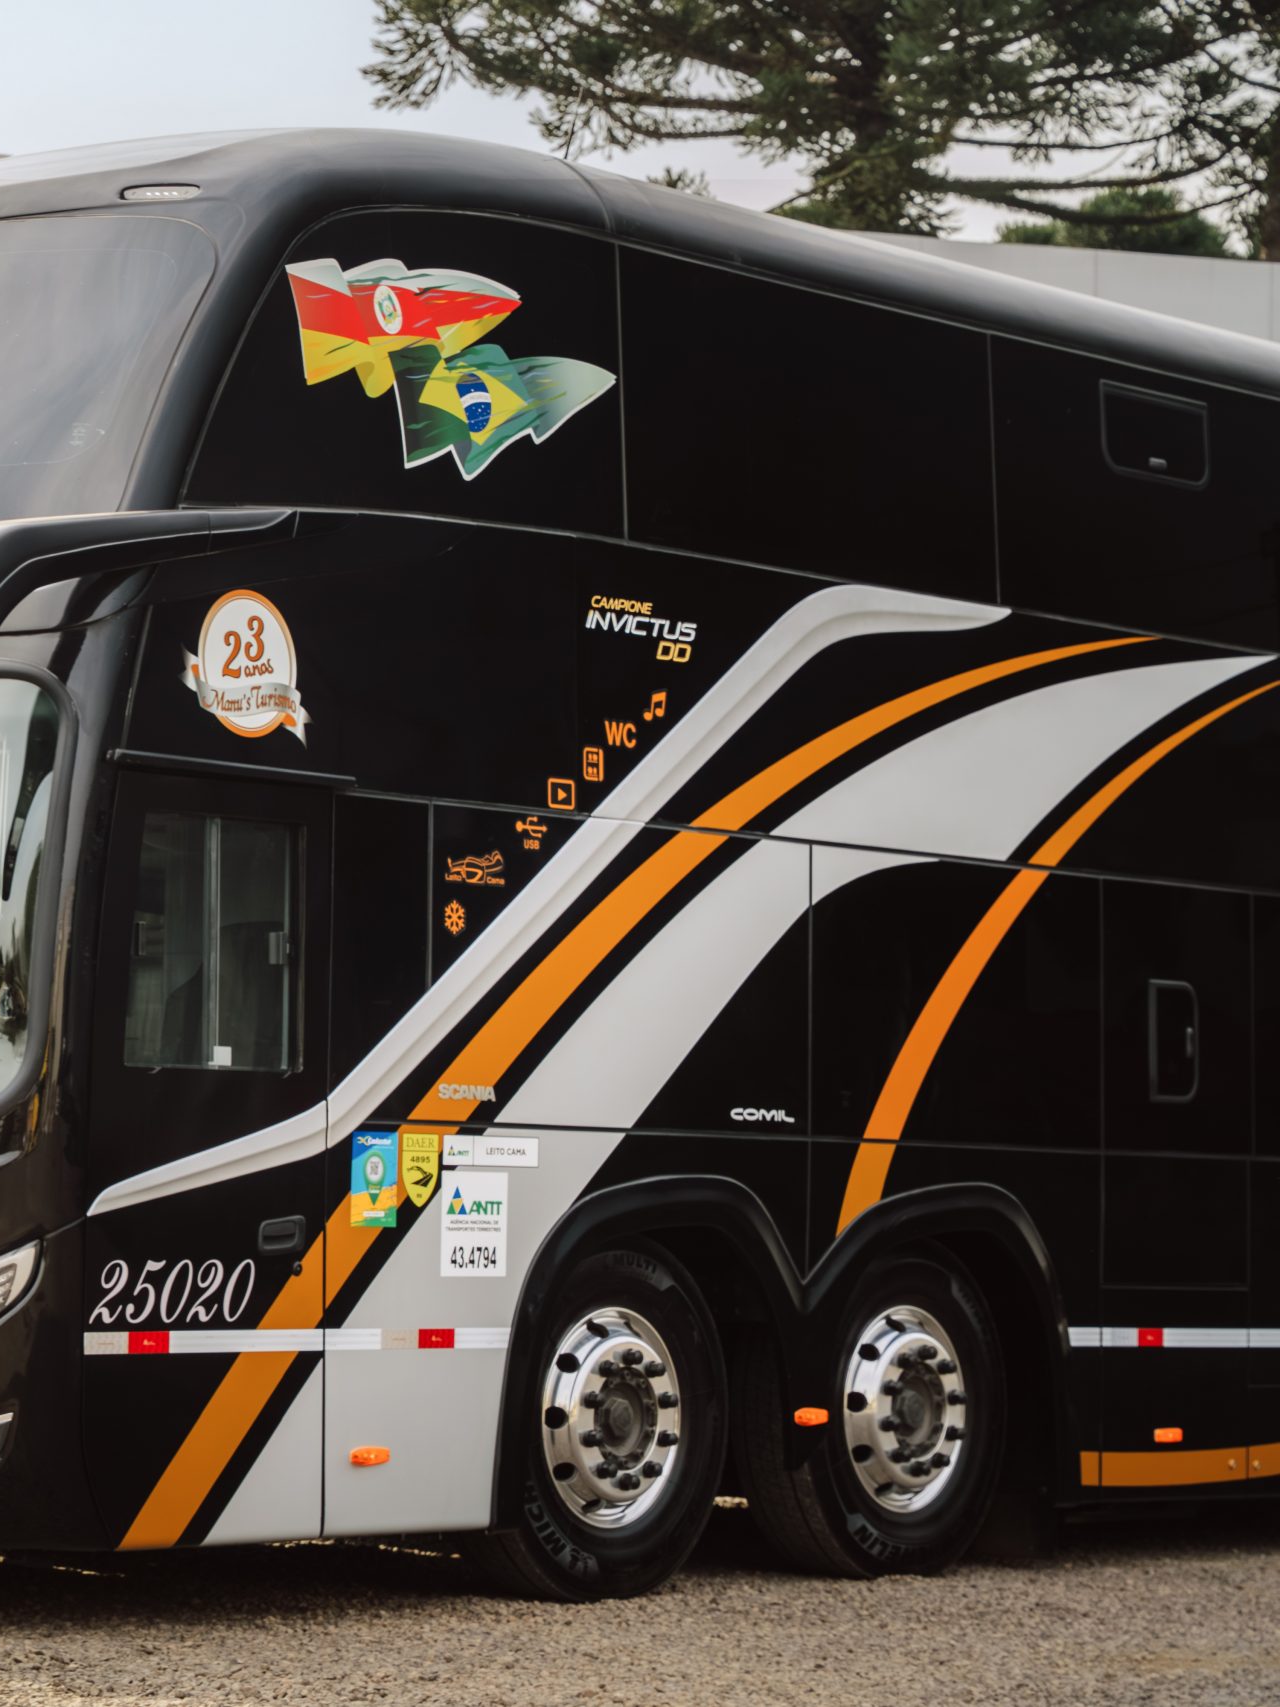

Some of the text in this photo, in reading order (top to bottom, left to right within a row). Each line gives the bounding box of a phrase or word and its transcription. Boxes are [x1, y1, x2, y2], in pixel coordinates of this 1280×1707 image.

[591, 595, 653, 615] CAMPIONE
[585, 609, 698, 642] INVICTUS
[222, 615, 265, 679] 23
[656, 640, 692, 663] DD
[202, 685, 296, 714] Manu's Turismo
[605, 720, 637, 749] WC
[524, 839, 540, 850] USB
[438, 1083, 496, 1102] SCANIA
[730, 1107, 795, 1123] COMIL
[406, 1137, 436, 1149] DAER
[486, 1148, 527, 1156] LEITO CAMA
[410, 1156, 431, 1164] 4895
[469, 1200, 503, 1216] ANTT
[450, 1246, 497, 1269] 43.4794
[88, 1258, 256, 1325] 25020
